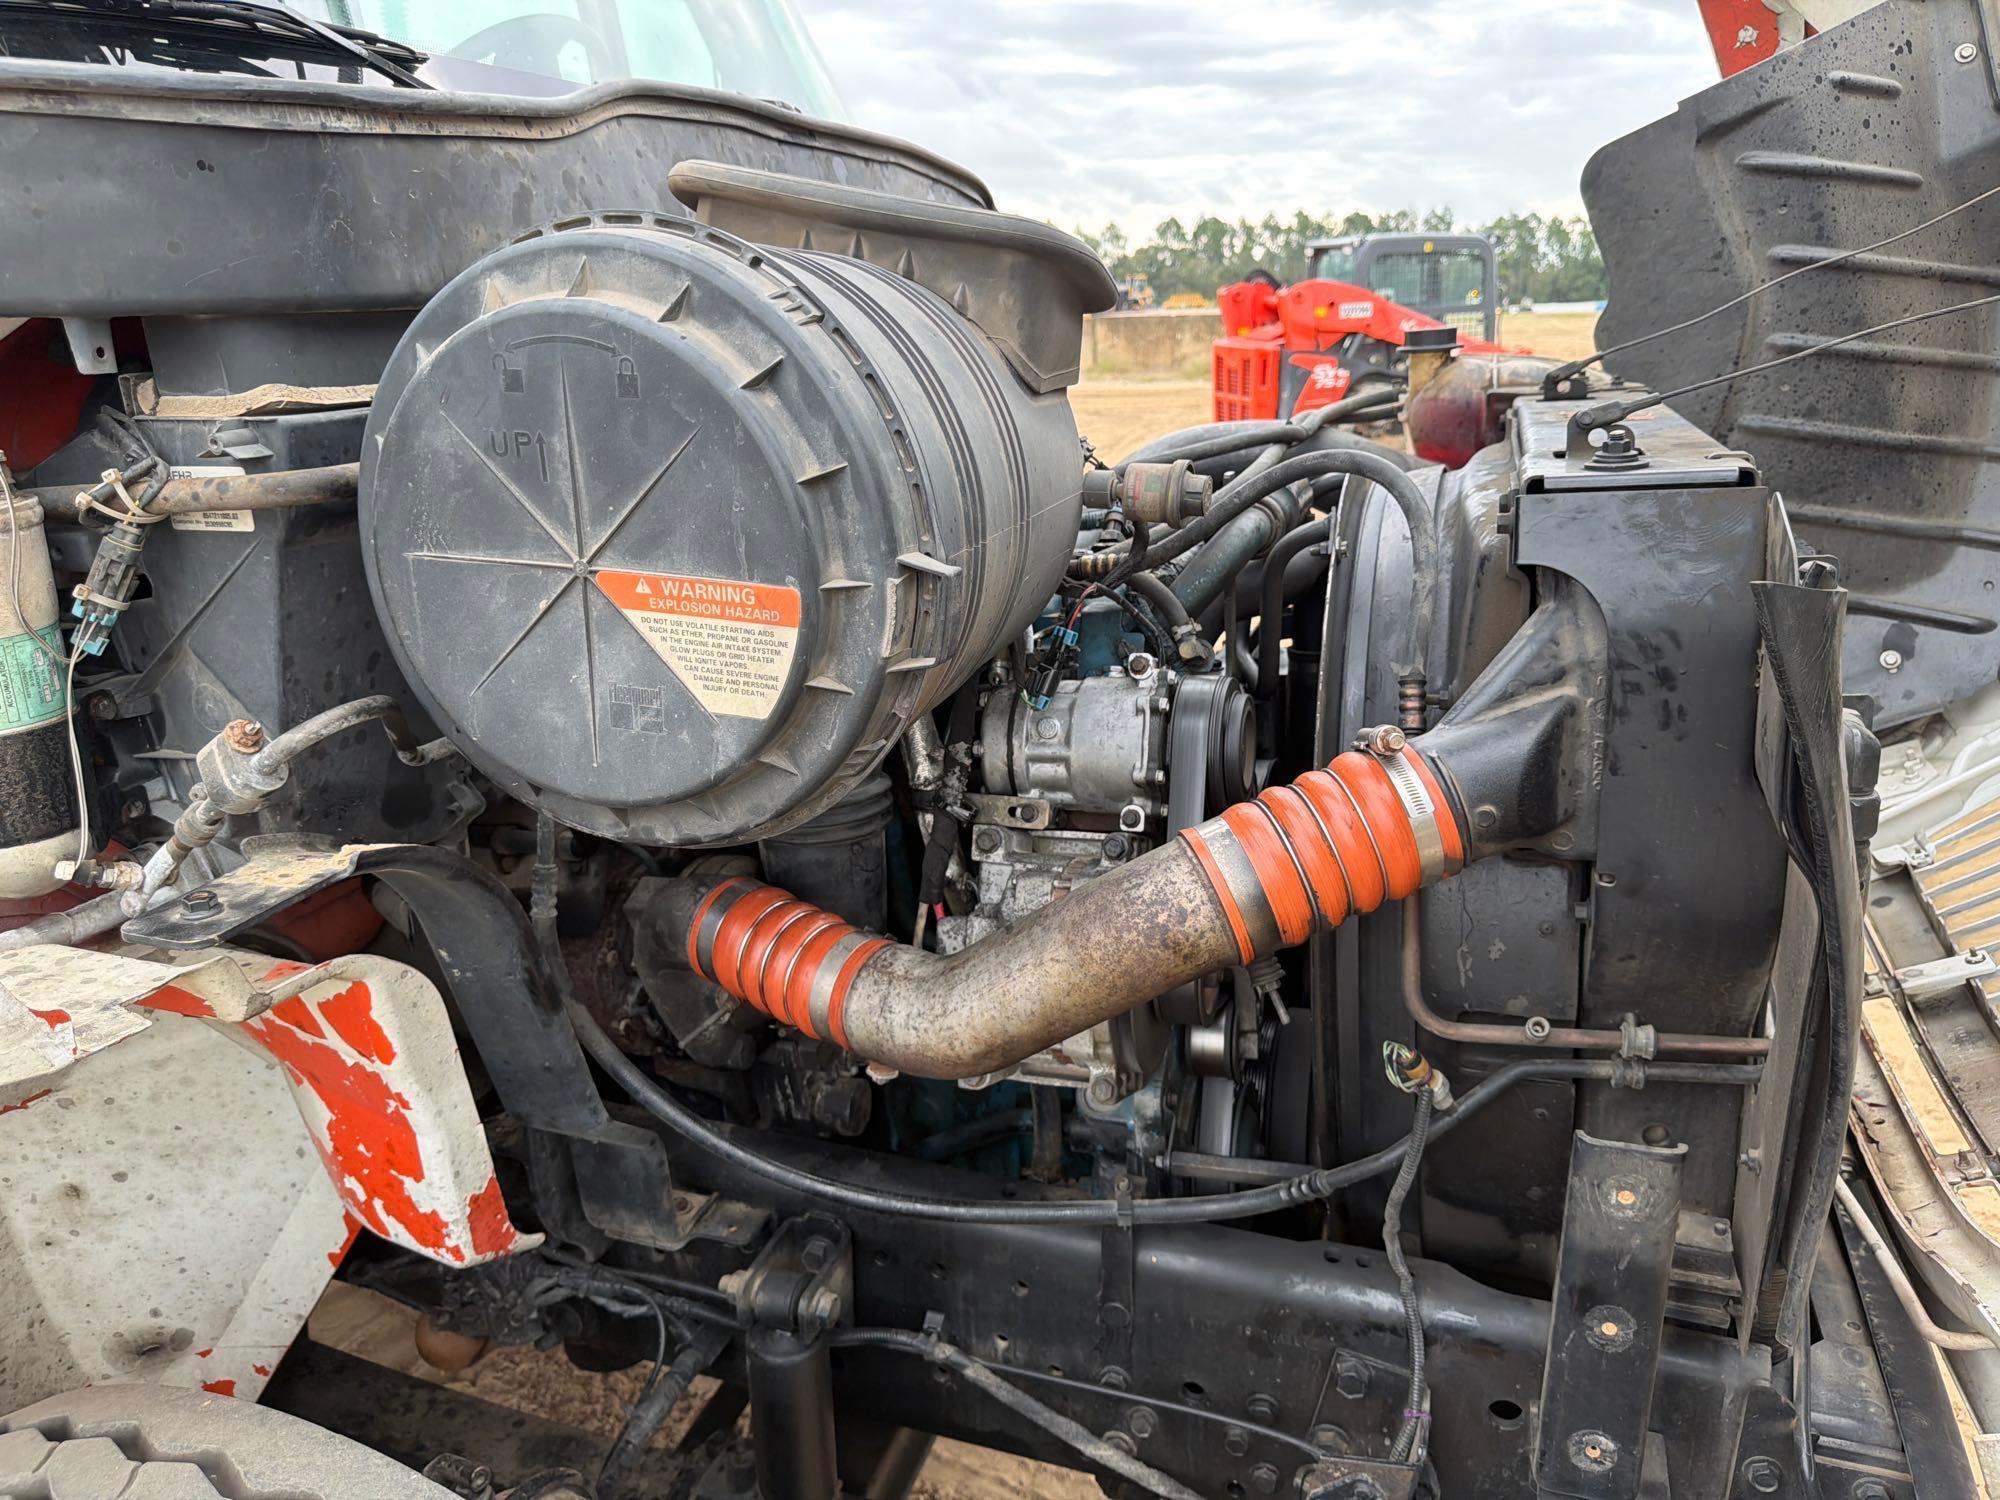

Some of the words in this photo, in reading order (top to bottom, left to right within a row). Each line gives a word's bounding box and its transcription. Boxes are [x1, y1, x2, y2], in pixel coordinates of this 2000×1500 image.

[490, 431, 532, 459] UP
[660, 580, 756, 605] WARNING
[649, 597, 720, 615] EXPLOSION
[725, 606, 780, 622] HAZARD
[648, 626, 668, 634] SUCH
[669, 628, 679, 636] AS
[707, 632, 739, 643] PROPANE
[753, 638, 789, 648] GASOLINE
[653, 618, 668, 626] NOT
[670, 619, 684, 628] USE
[686, 620, 719, 632] VOLATILE
[720, 624, 755, 636] STARTING
[757, 630, 775, 638] AIDS
[670, 637, 682, 645] THE
[684, 639, 711, 648] ENGINE
[725, 644, 750, 653] INTAKE
[752, 647, 783, 657] SYSTEM.
[670, 645, 691, 654] GLOW
[692, 648, 715, 658] PLUGS
[728, 653, 745, 661] GRID
[747, 655, 775, 664] HEATER
[677, 655, 693, 663] WILL
[695, 657, 717, 666] IGNITE
[683, 664, 699, 673] CAN
[701, 667, 724, 676] CAUSE
[726, 670, 753, 679] SEVERE
[754, 673, 780, 682] ENGINE
[693, 674, 724, 684] DAMAGE
[725, 678, 741, 686] AND
[743, 680, 780, 691] PERSONAL
[703, 683, 727, 693] INJURY
[729, 687, 740, 695] OR
